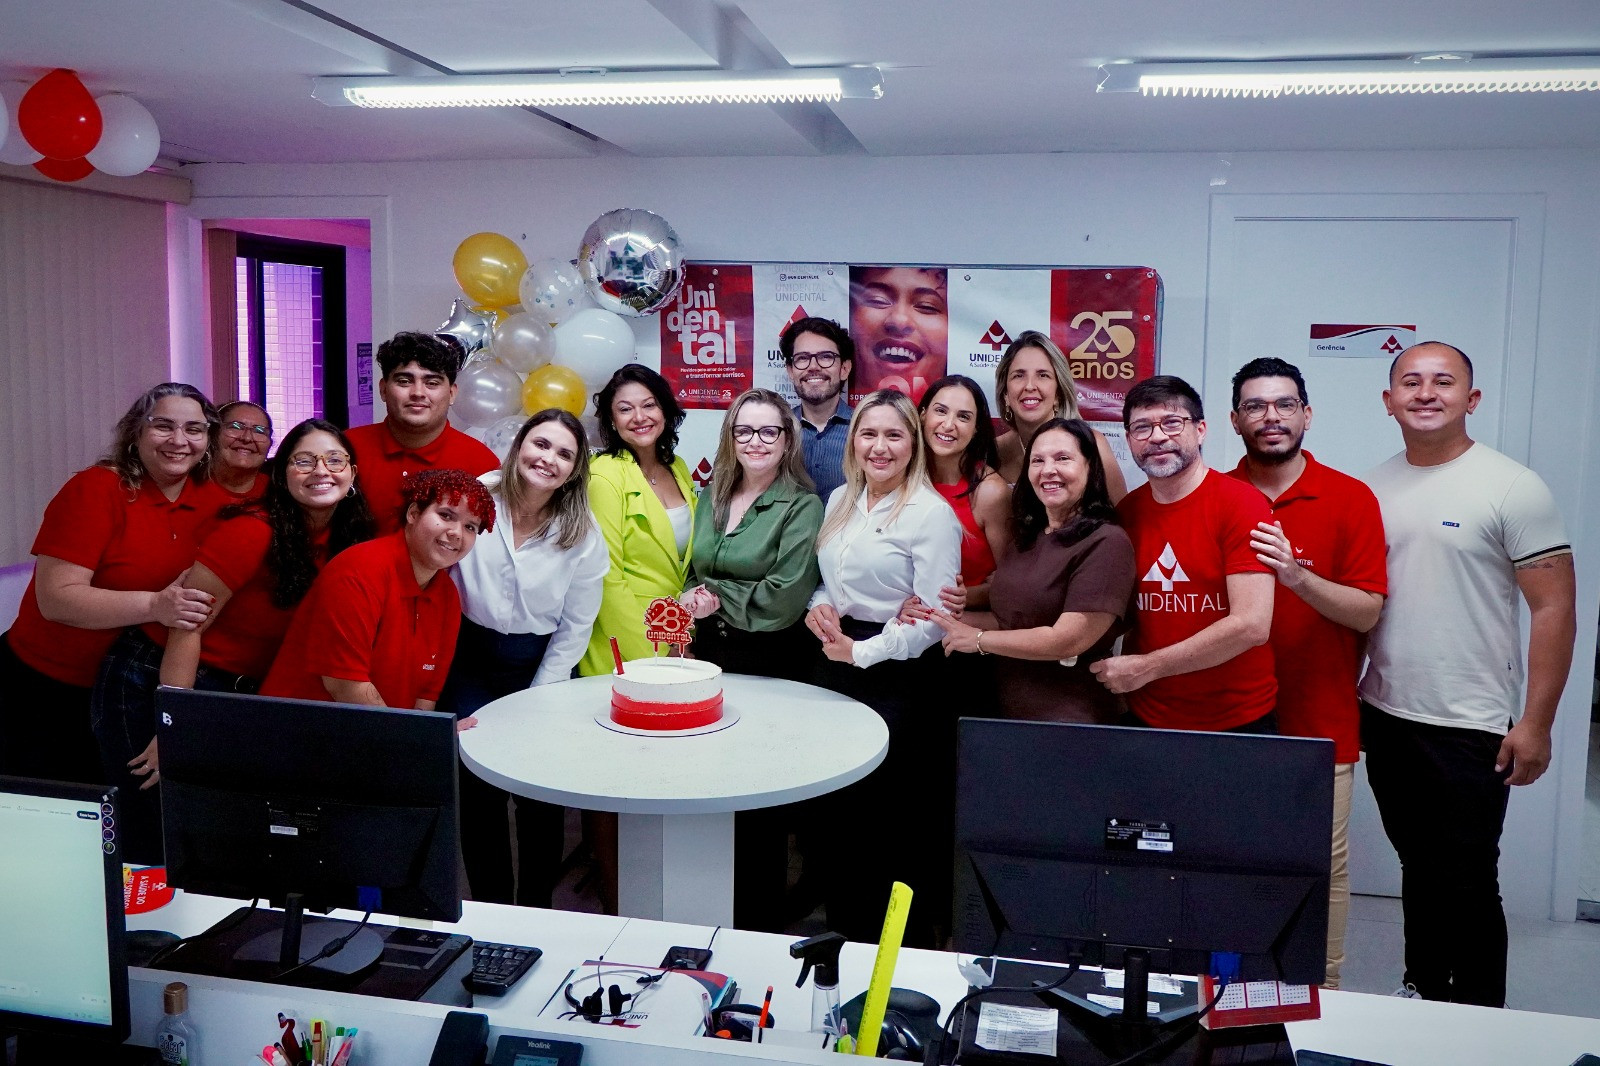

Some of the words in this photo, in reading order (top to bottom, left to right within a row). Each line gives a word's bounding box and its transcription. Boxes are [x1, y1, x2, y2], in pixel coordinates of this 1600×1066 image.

[677, 282, 716, 309] Uni
[775, 292, 827, 302] UNIDENTAL
[666, 303, 720, 332] den
[677, 320, 737, 365] tal
[1069, 310, 1136, 360] 25
[1316, 343, 1346, 351] Gerência
[1070, 359, 1135, 380] anos
[688, 388, 721, 396] UNIDENTAL
[650, 599, 681, 632] 28
[527, 1041, 551, 1049] Yealink
